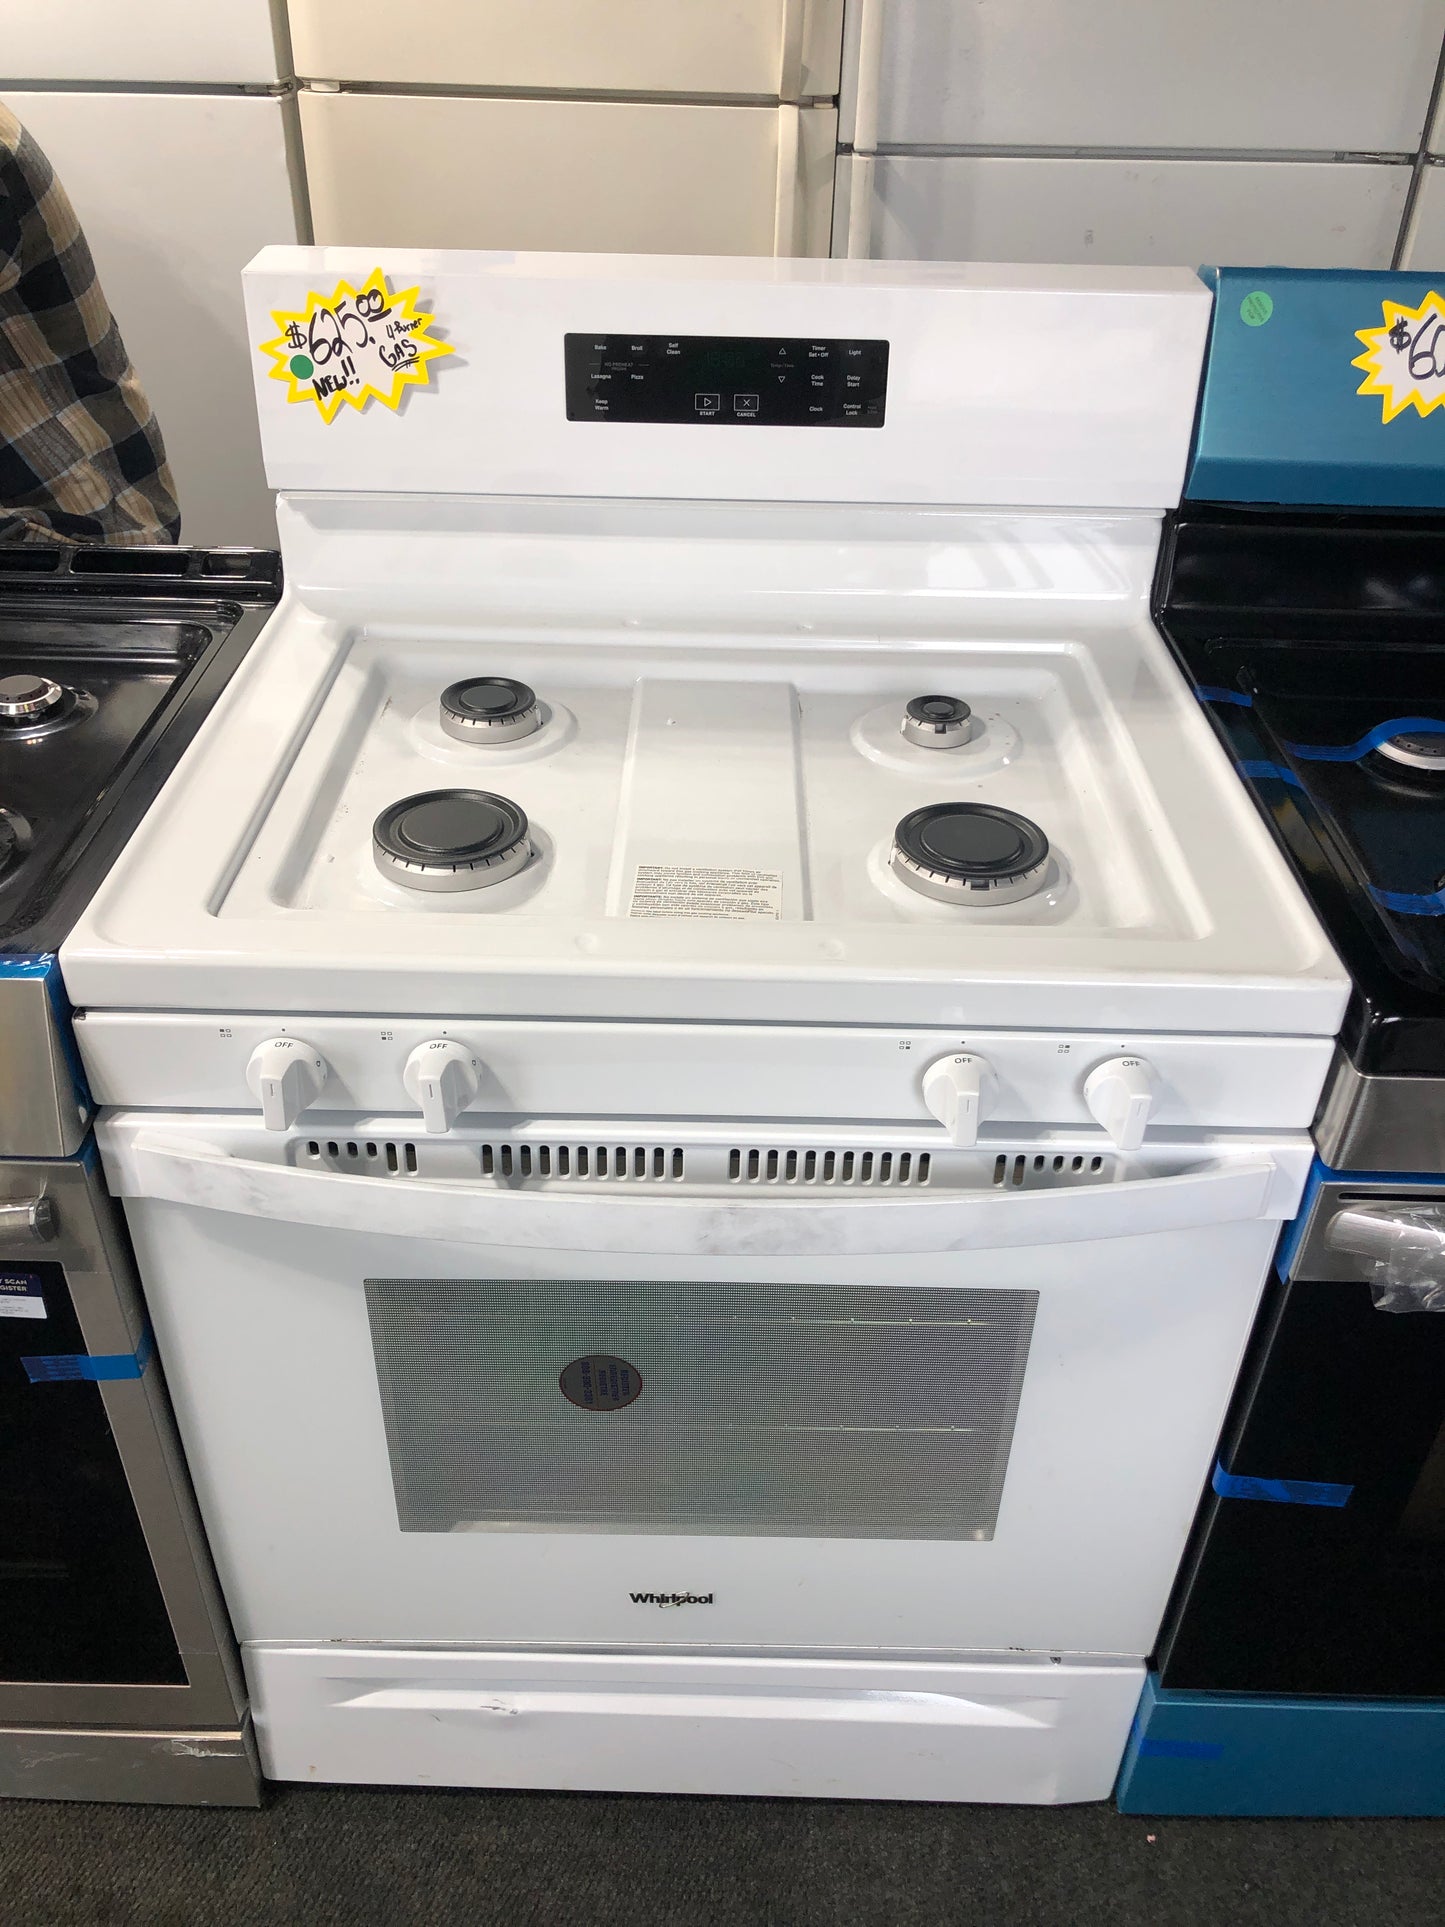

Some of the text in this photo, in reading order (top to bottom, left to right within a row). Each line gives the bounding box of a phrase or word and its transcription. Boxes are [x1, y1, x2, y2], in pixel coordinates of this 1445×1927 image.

[386, 325, 395, 340] 4
[379, 339, 417, 367] GAS
[312, 356, 360, 400] NEW!!
[274, 1041, 294, 1049] OFF
[629, 1591, 714, 1608] Whirlpool
